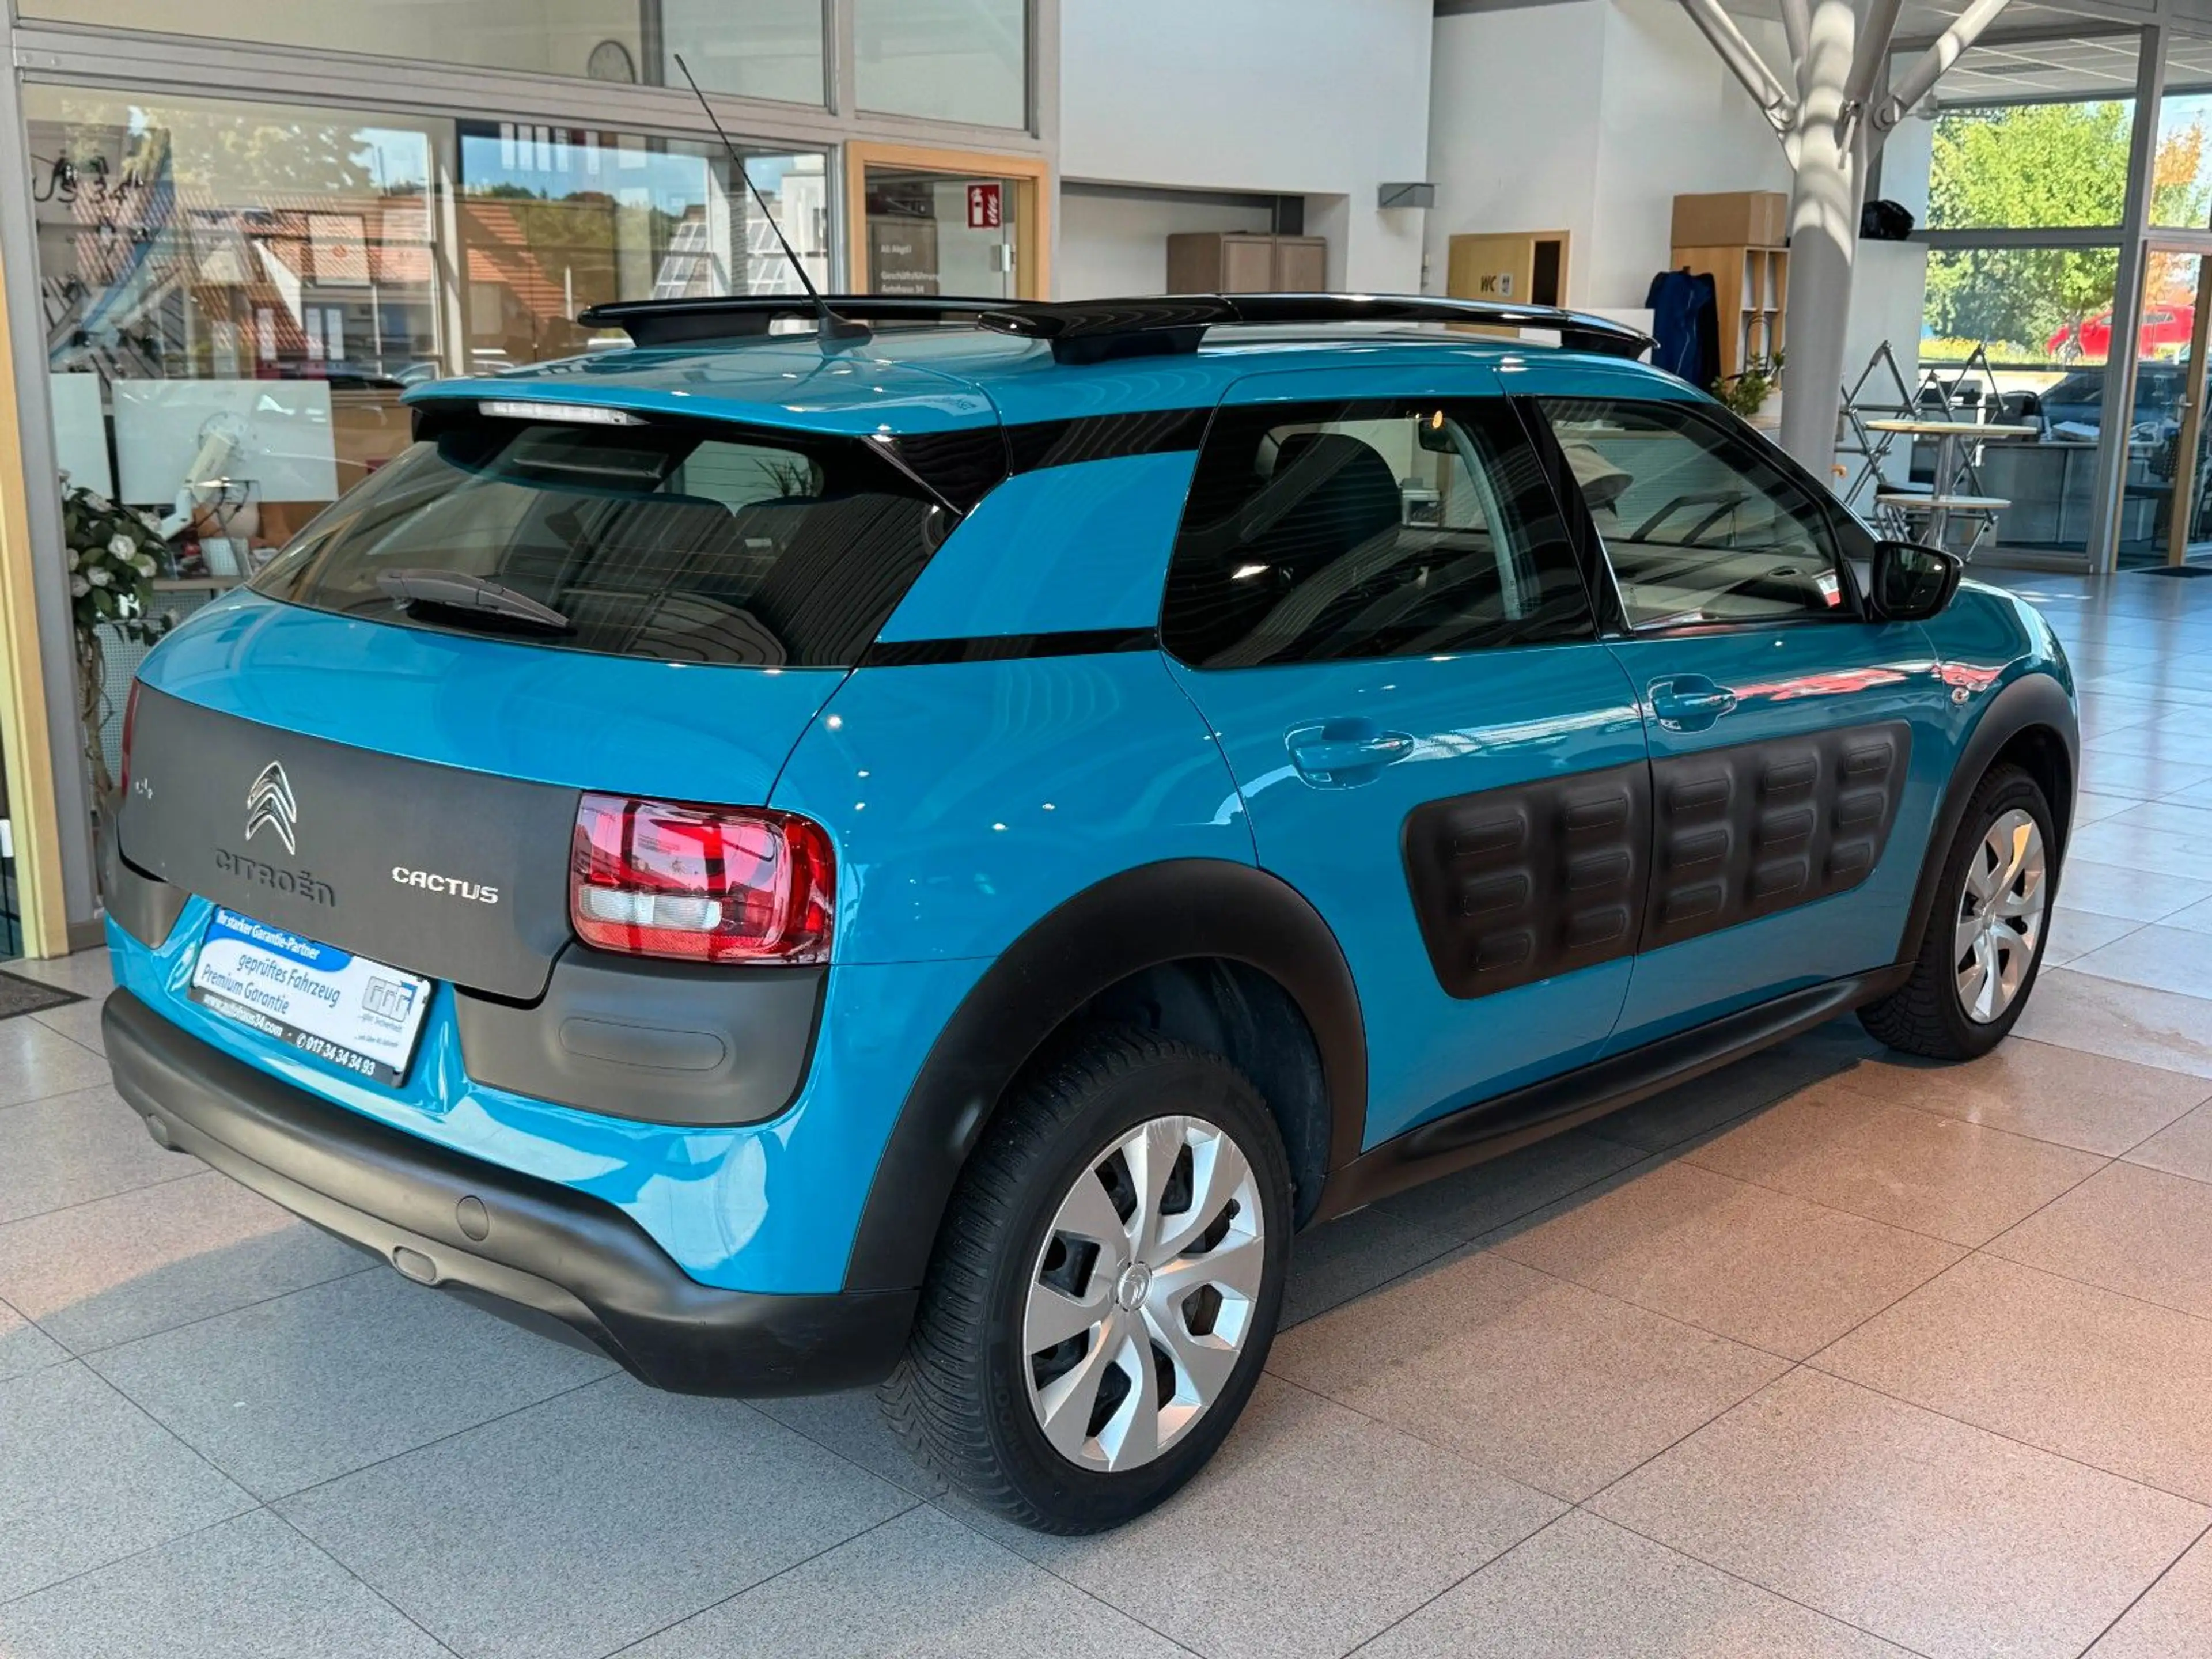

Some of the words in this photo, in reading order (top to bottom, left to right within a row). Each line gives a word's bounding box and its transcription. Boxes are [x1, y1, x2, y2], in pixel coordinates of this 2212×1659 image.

[1480, 275, 1497, 293] WC
[391, 866, 499, 904] CACTUS
[252, 925, 321, 961] Garantie-Partner
[201, 963, 244, 997] Premium
[244, 981, 290, 1014] Garantie
[236, 953, 287, 984] geprüftes
[287, 968, 342, 1009] Fahrzeug
[322, 1043, 337, 1060] 34
[335, 1048, 350, 1066] 34
[347, 1054, 362, 1072] 34
[360, 1058, 376, 1077] 93
